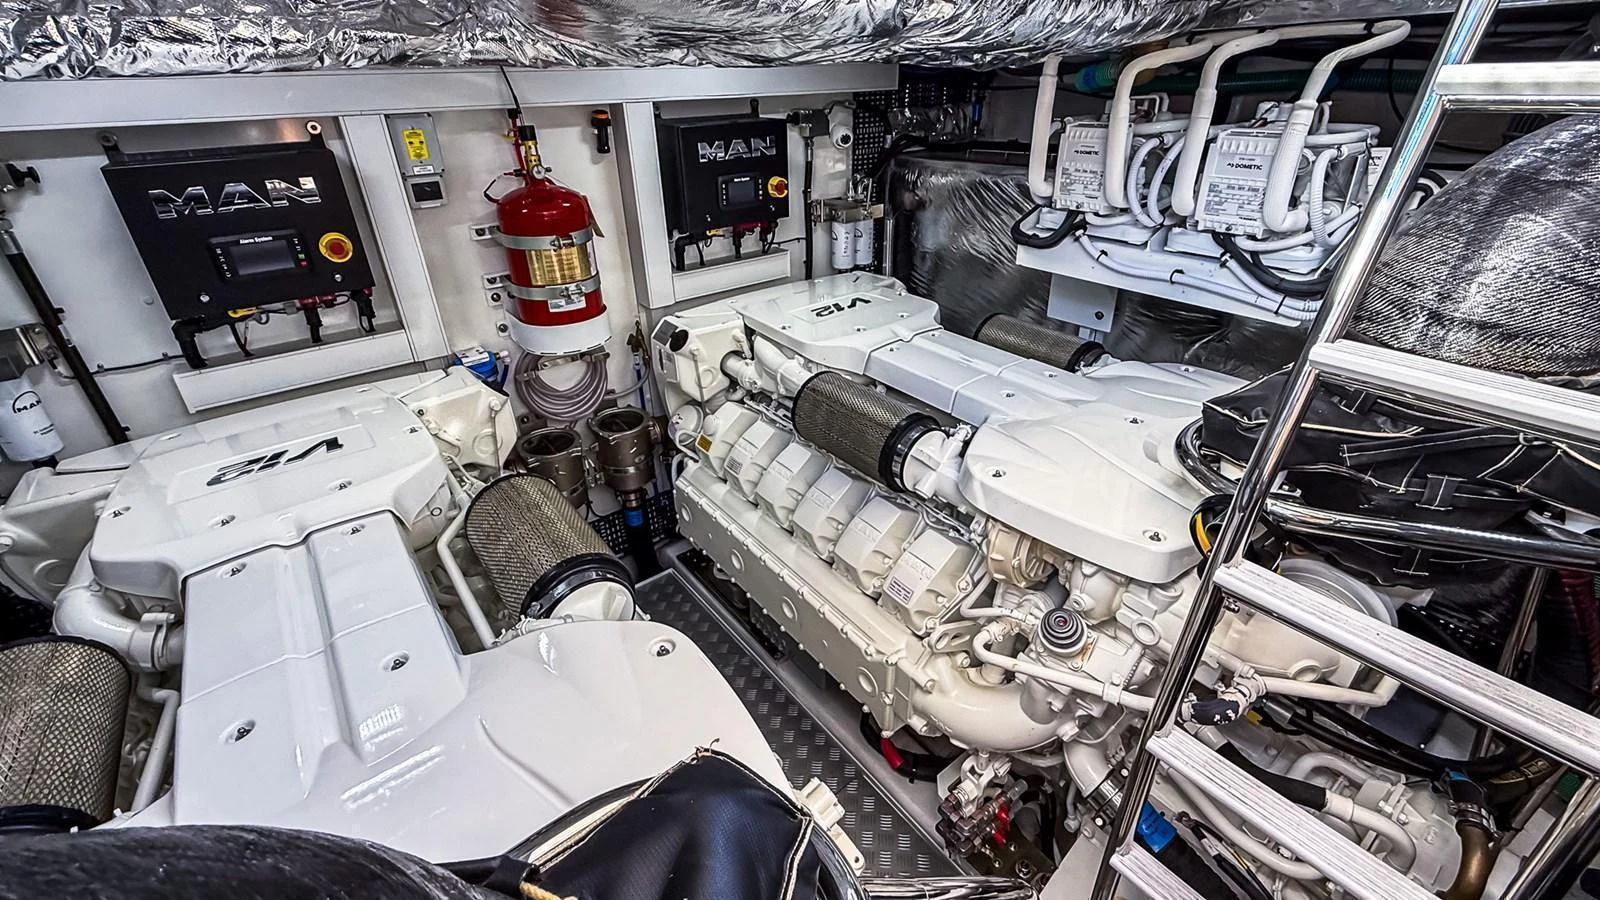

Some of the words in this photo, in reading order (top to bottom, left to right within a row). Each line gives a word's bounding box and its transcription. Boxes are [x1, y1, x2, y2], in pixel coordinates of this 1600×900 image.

[697, 135, 776, 162] MAN
[148, 176, 321, 219] MAN
[810, 297, 872, 317] V12
[206, 436, 344, 486] V12
